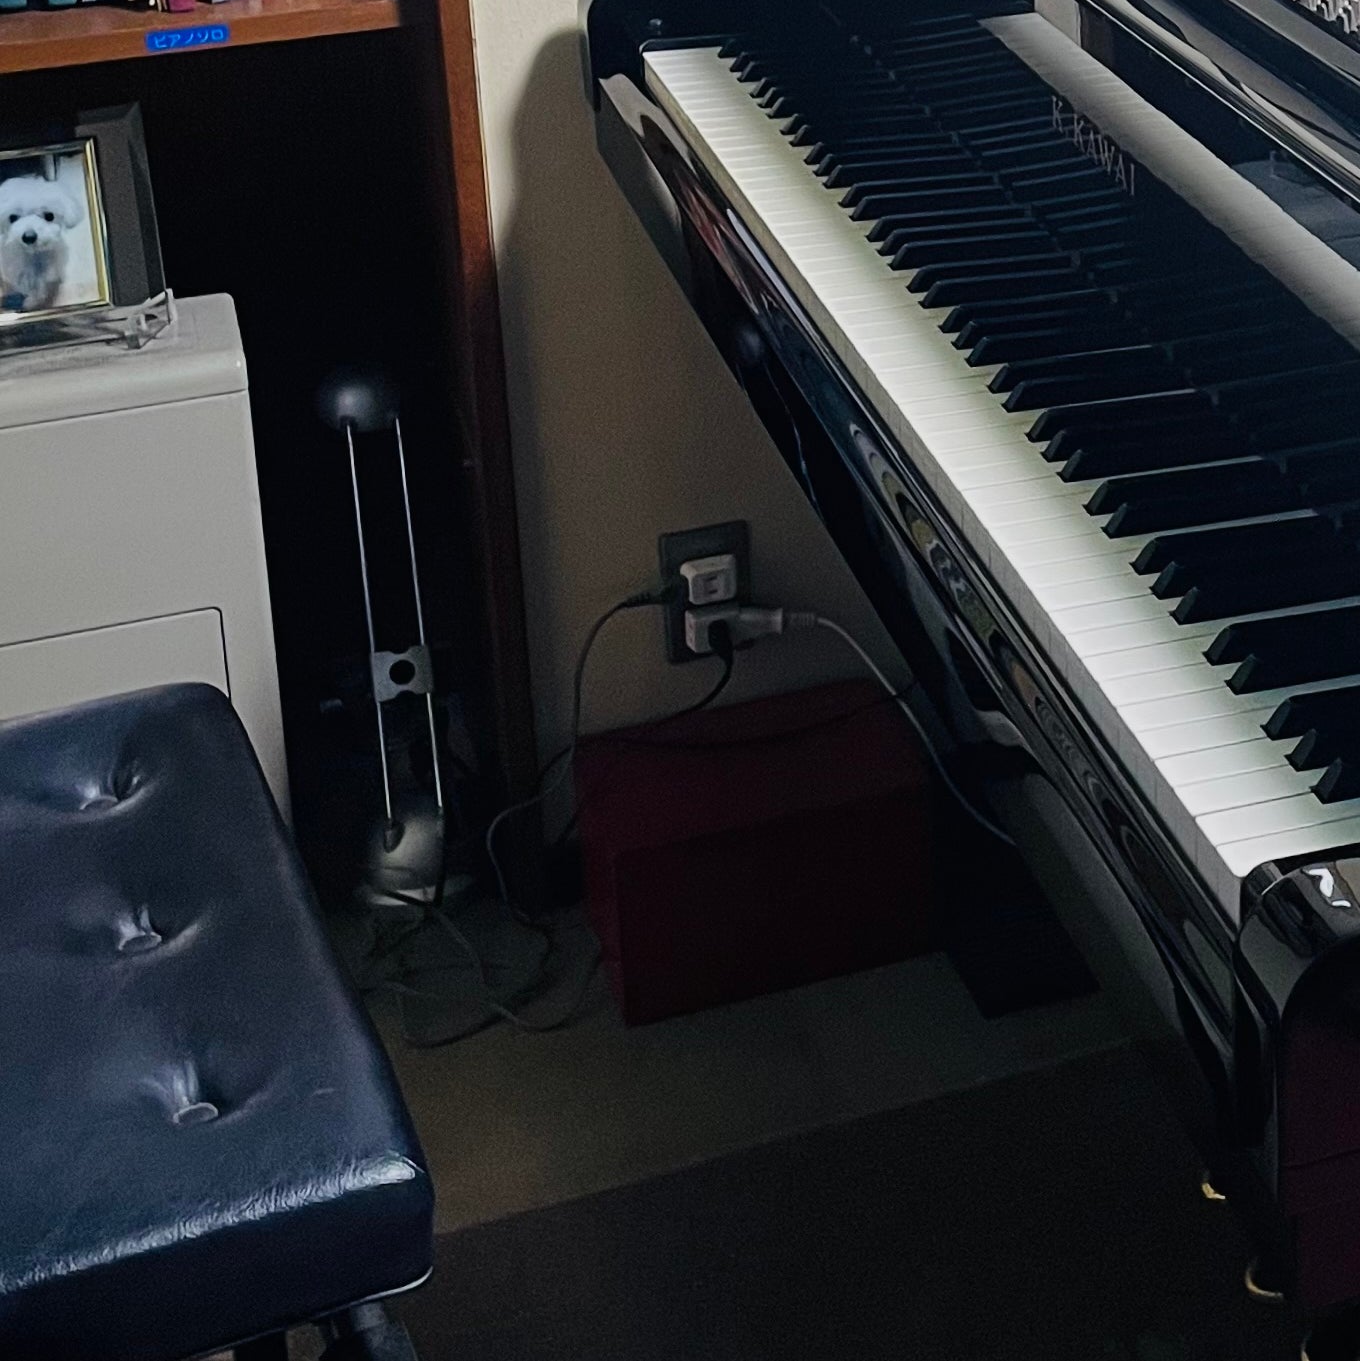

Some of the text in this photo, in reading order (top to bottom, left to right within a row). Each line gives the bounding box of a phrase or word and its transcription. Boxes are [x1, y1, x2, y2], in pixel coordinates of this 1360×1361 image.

[153, 28, 224, 49] ピアノソロ
[1073, 113, 1135, 197] KAWAI
